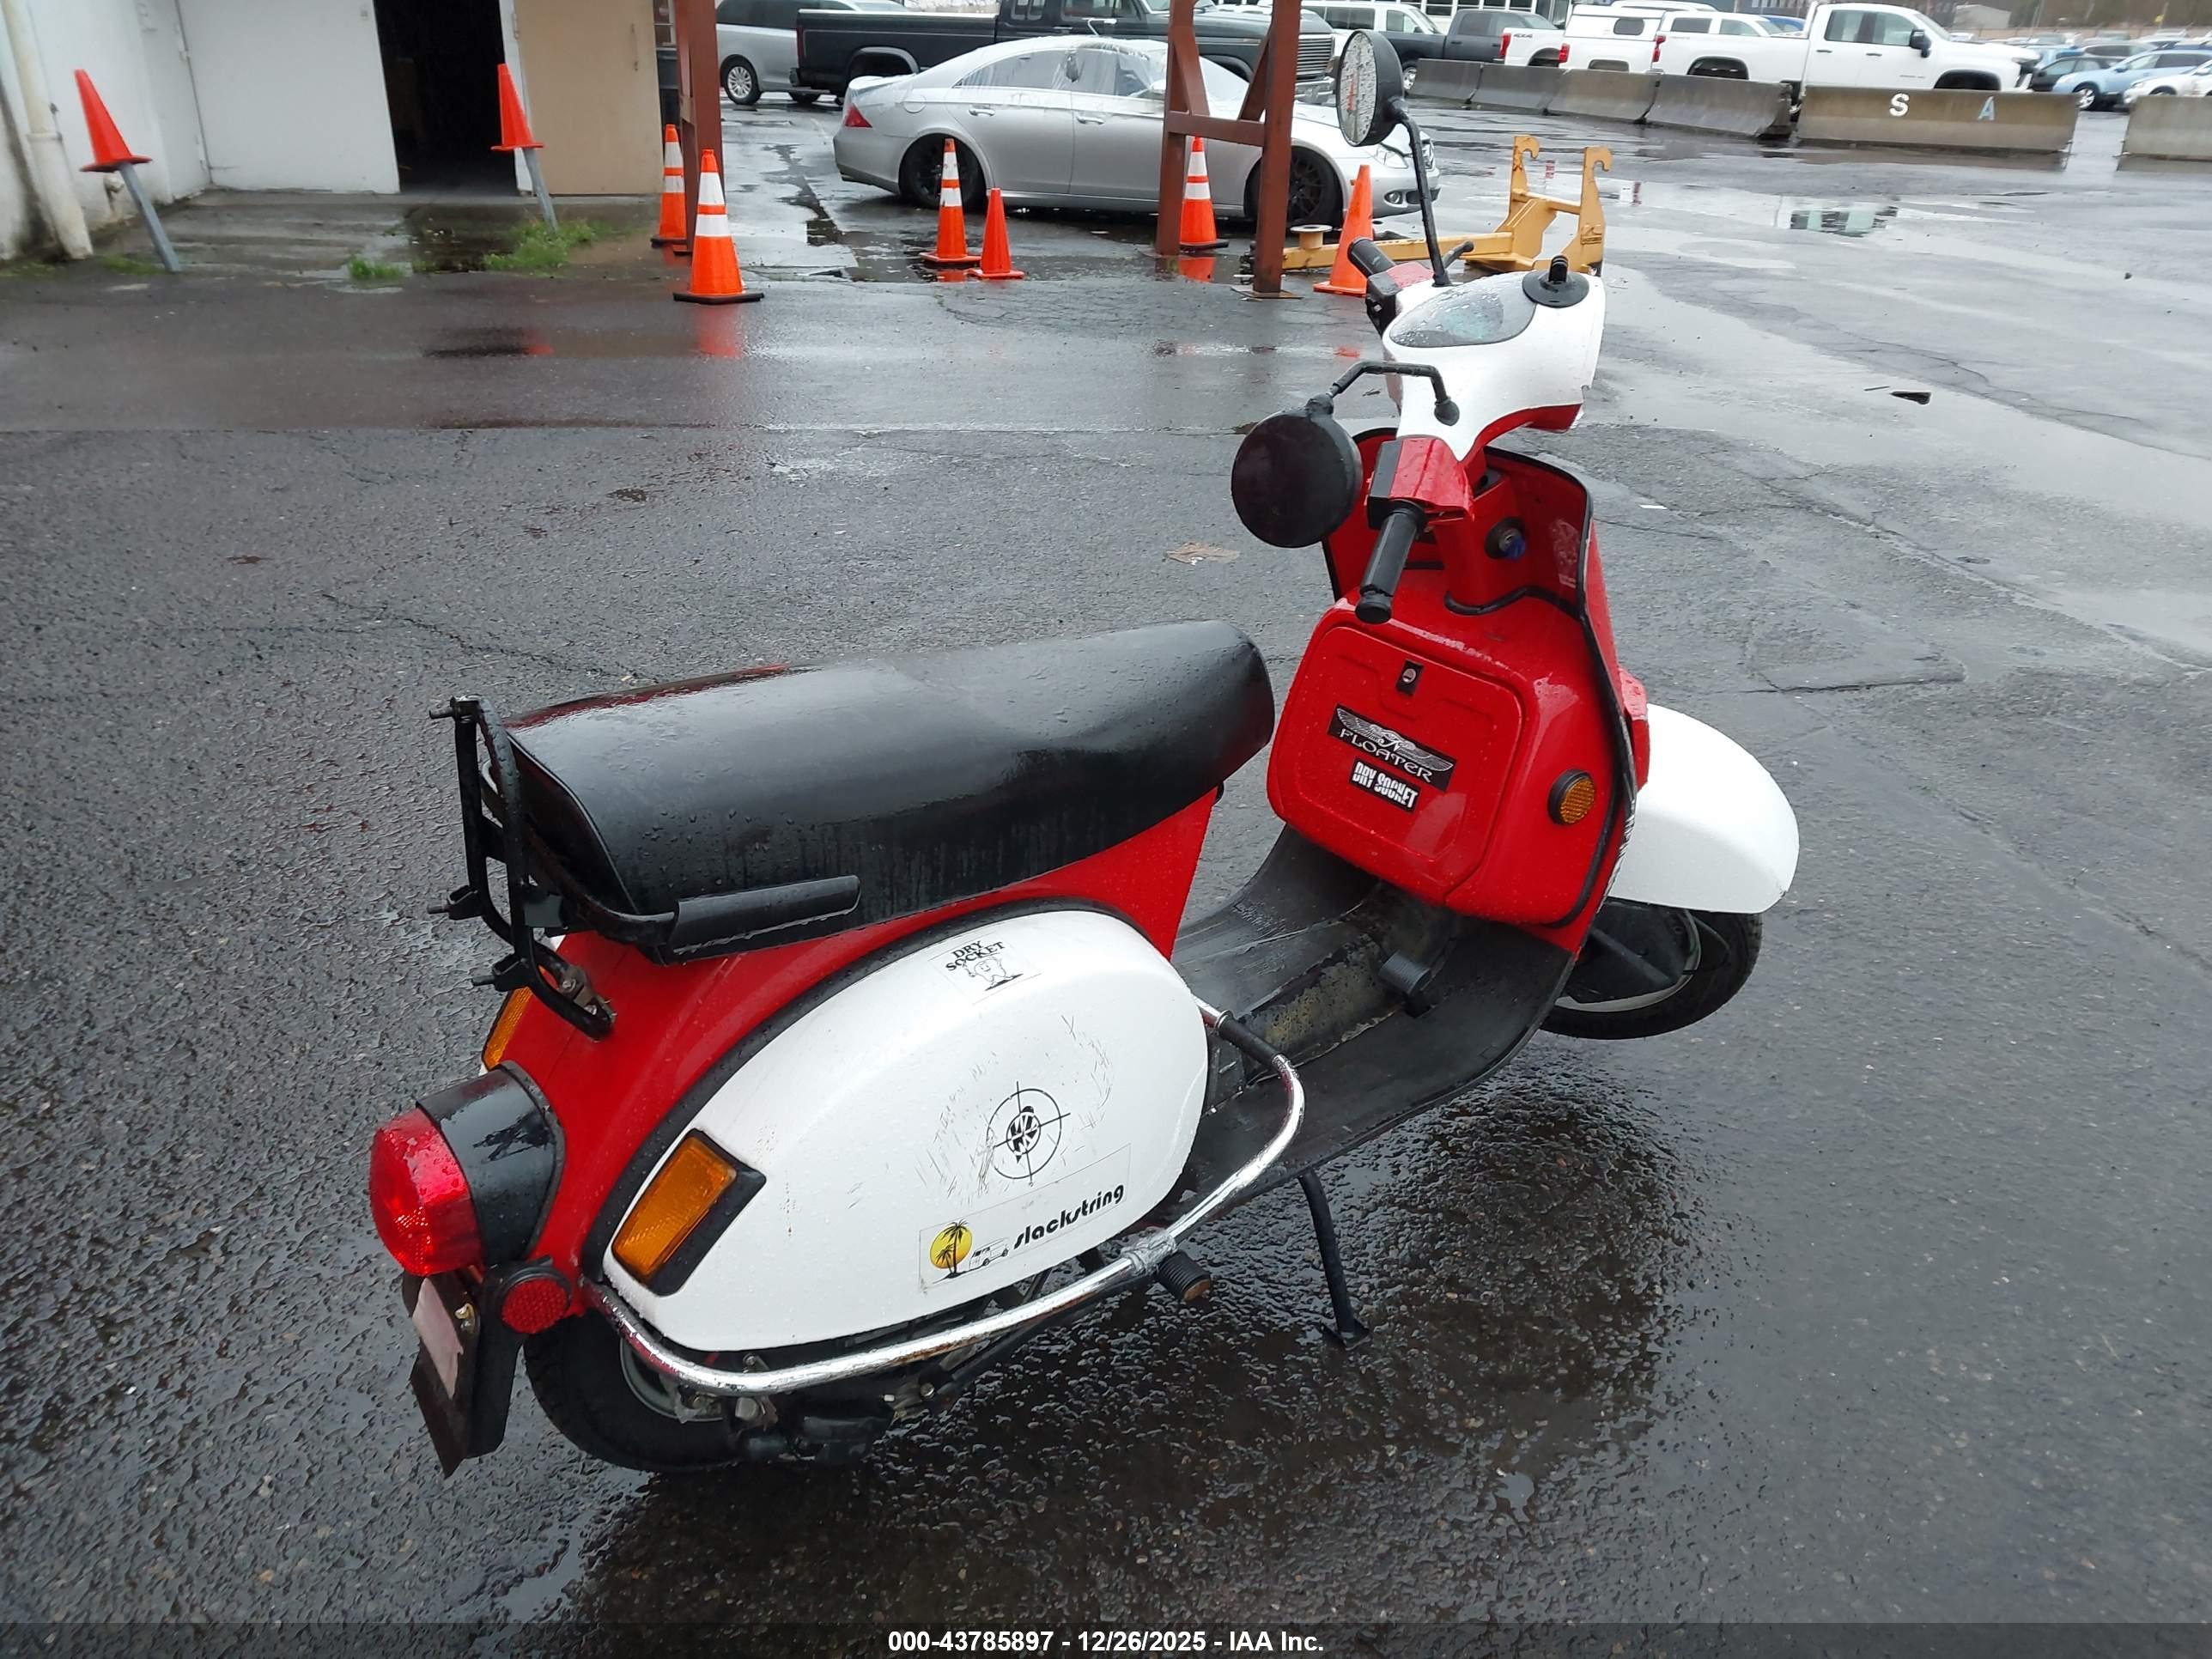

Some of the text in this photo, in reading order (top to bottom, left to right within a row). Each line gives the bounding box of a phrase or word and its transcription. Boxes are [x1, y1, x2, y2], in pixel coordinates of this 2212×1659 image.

[1889, 93, 1995, 120] S A
[1339, 728, 1433, 783] FLOATER
[945, 941, 1006, 971] SOCKET
[951, 940, 984, 958] DRY
[1013, 1184, 1124, 1249] slackstring
